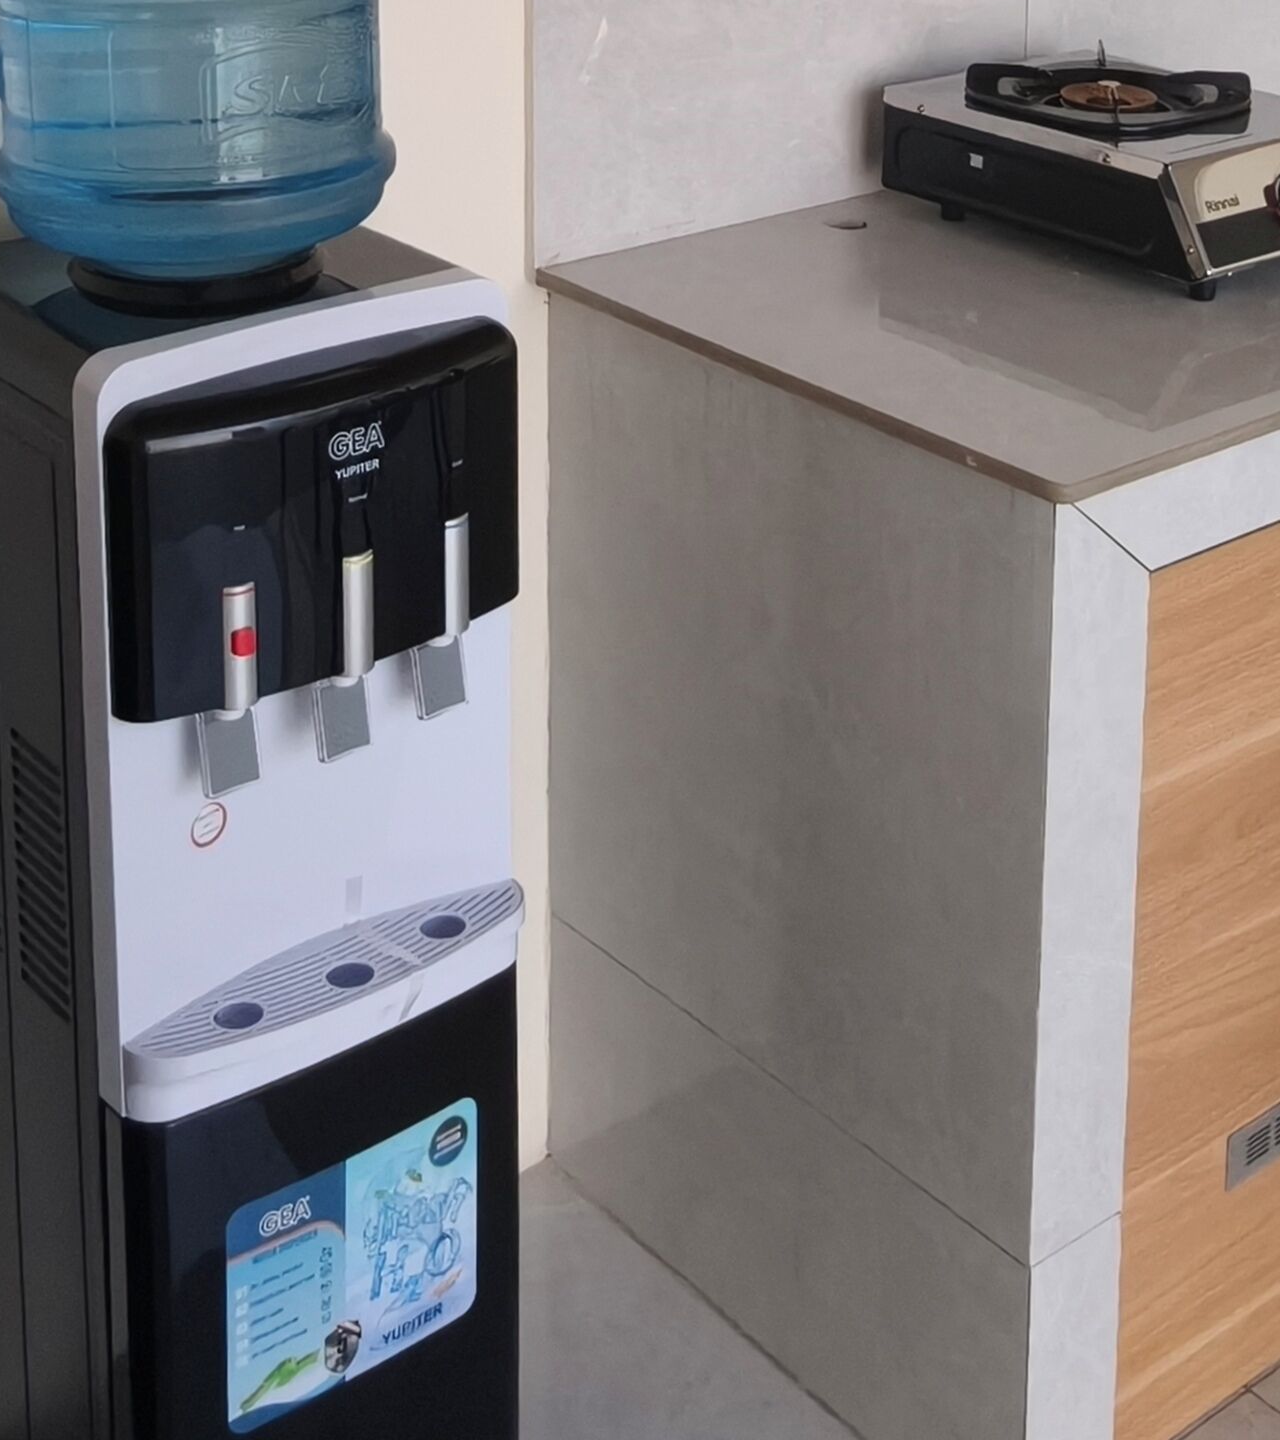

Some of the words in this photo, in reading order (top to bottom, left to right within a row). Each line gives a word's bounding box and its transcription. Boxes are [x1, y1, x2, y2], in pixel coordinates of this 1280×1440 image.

[1204, 194, 1240, 214] Rinnai
[328, 421, 385, 461] GEA
[335, 458, 380, 479] YUPITER
[259, 1195, 311, 1237] GEA
[382, 1302, 443, 1344] YUPITER
